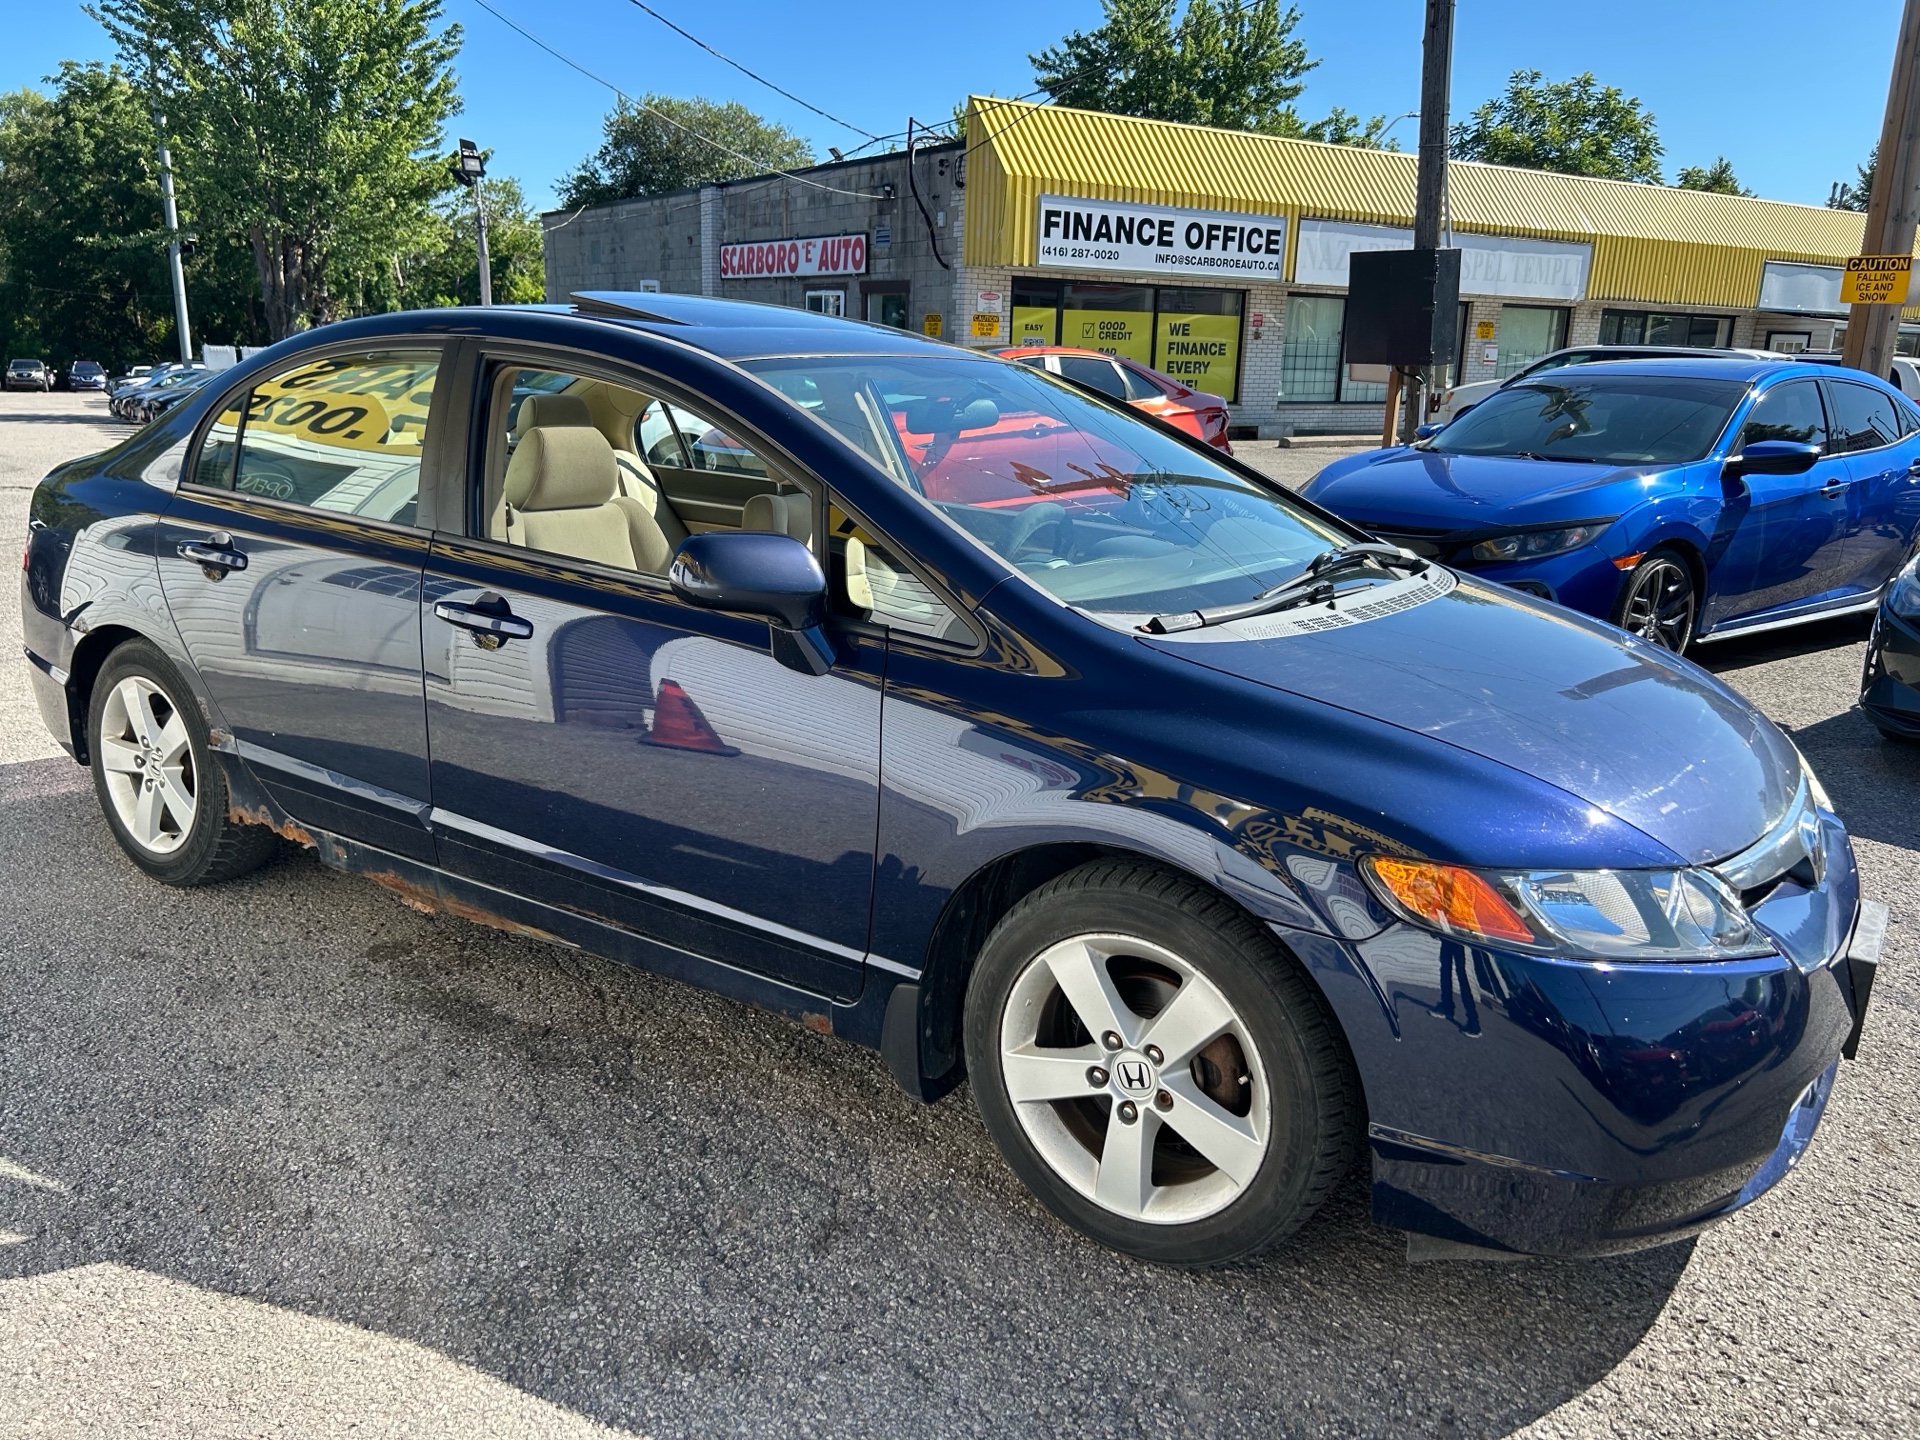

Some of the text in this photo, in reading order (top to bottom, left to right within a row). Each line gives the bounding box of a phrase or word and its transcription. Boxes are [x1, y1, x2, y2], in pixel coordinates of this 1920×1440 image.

[1043, 209, 1281, 255] FINANCE OFFICE
[721, 242, 799, 276] SCARBORO
[817, 236, 865, 271] AUTO
[1042, 245, 1119, 260] (416) 287-0020
[1154, 253, 1280, 271] INFO@SCARBOROEAUTO.CA
[1849, 258, 1909, 271] CAUTION
[1856, 272, 1896, 282] FALLING
[1855, 283, 1894, 291] ICE AND
[1858, 292, 1888, 302] SNOW
[1024, 323, 1044, 331] EASY
[1098, 321, 1126, 331] GOOD
[1168, 322, 1190, 336] WE
[1098, 331, 1133, 341] CREDIT
[1167, 341, 1227, 356] FINANCE
[1166, 360, 1211, 375] EVERY
